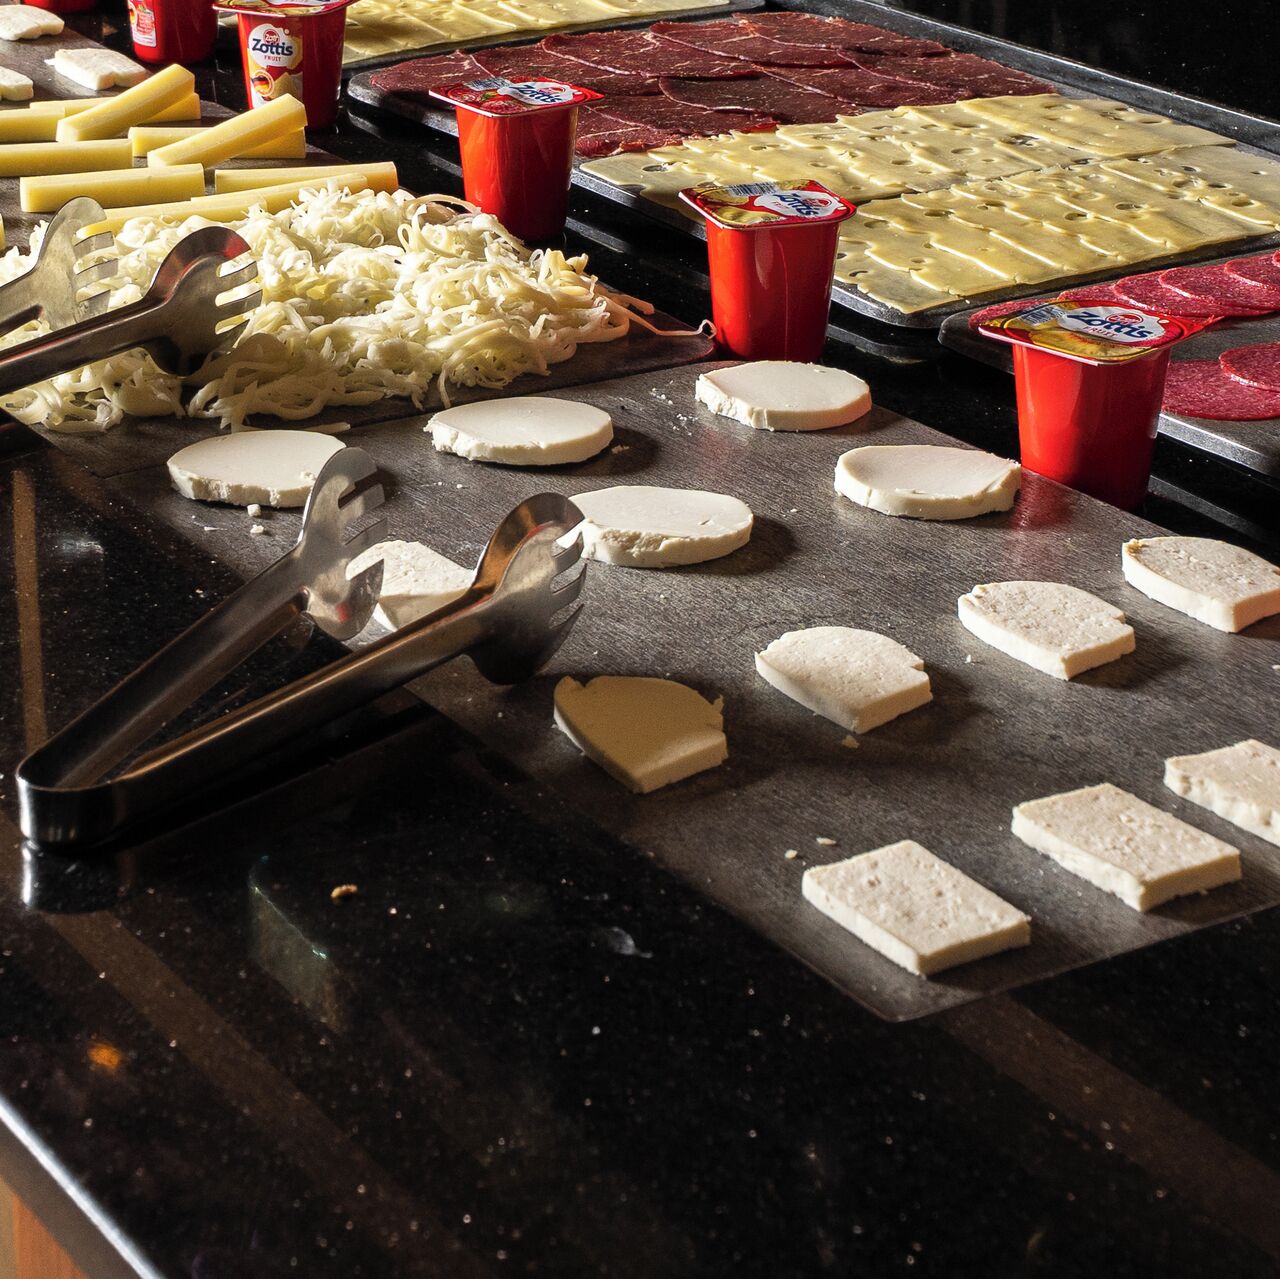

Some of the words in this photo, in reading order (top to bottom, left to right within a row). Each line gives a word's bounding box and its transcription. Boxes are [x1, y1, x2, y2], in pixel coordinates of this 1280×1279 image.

[251, 37, 294, 57] Zottis
[772, 193, 820, 216] Zottis
[1066, 311, 1154, 339] Zottis
[1083, 326, 1119, 338] FRUIT
